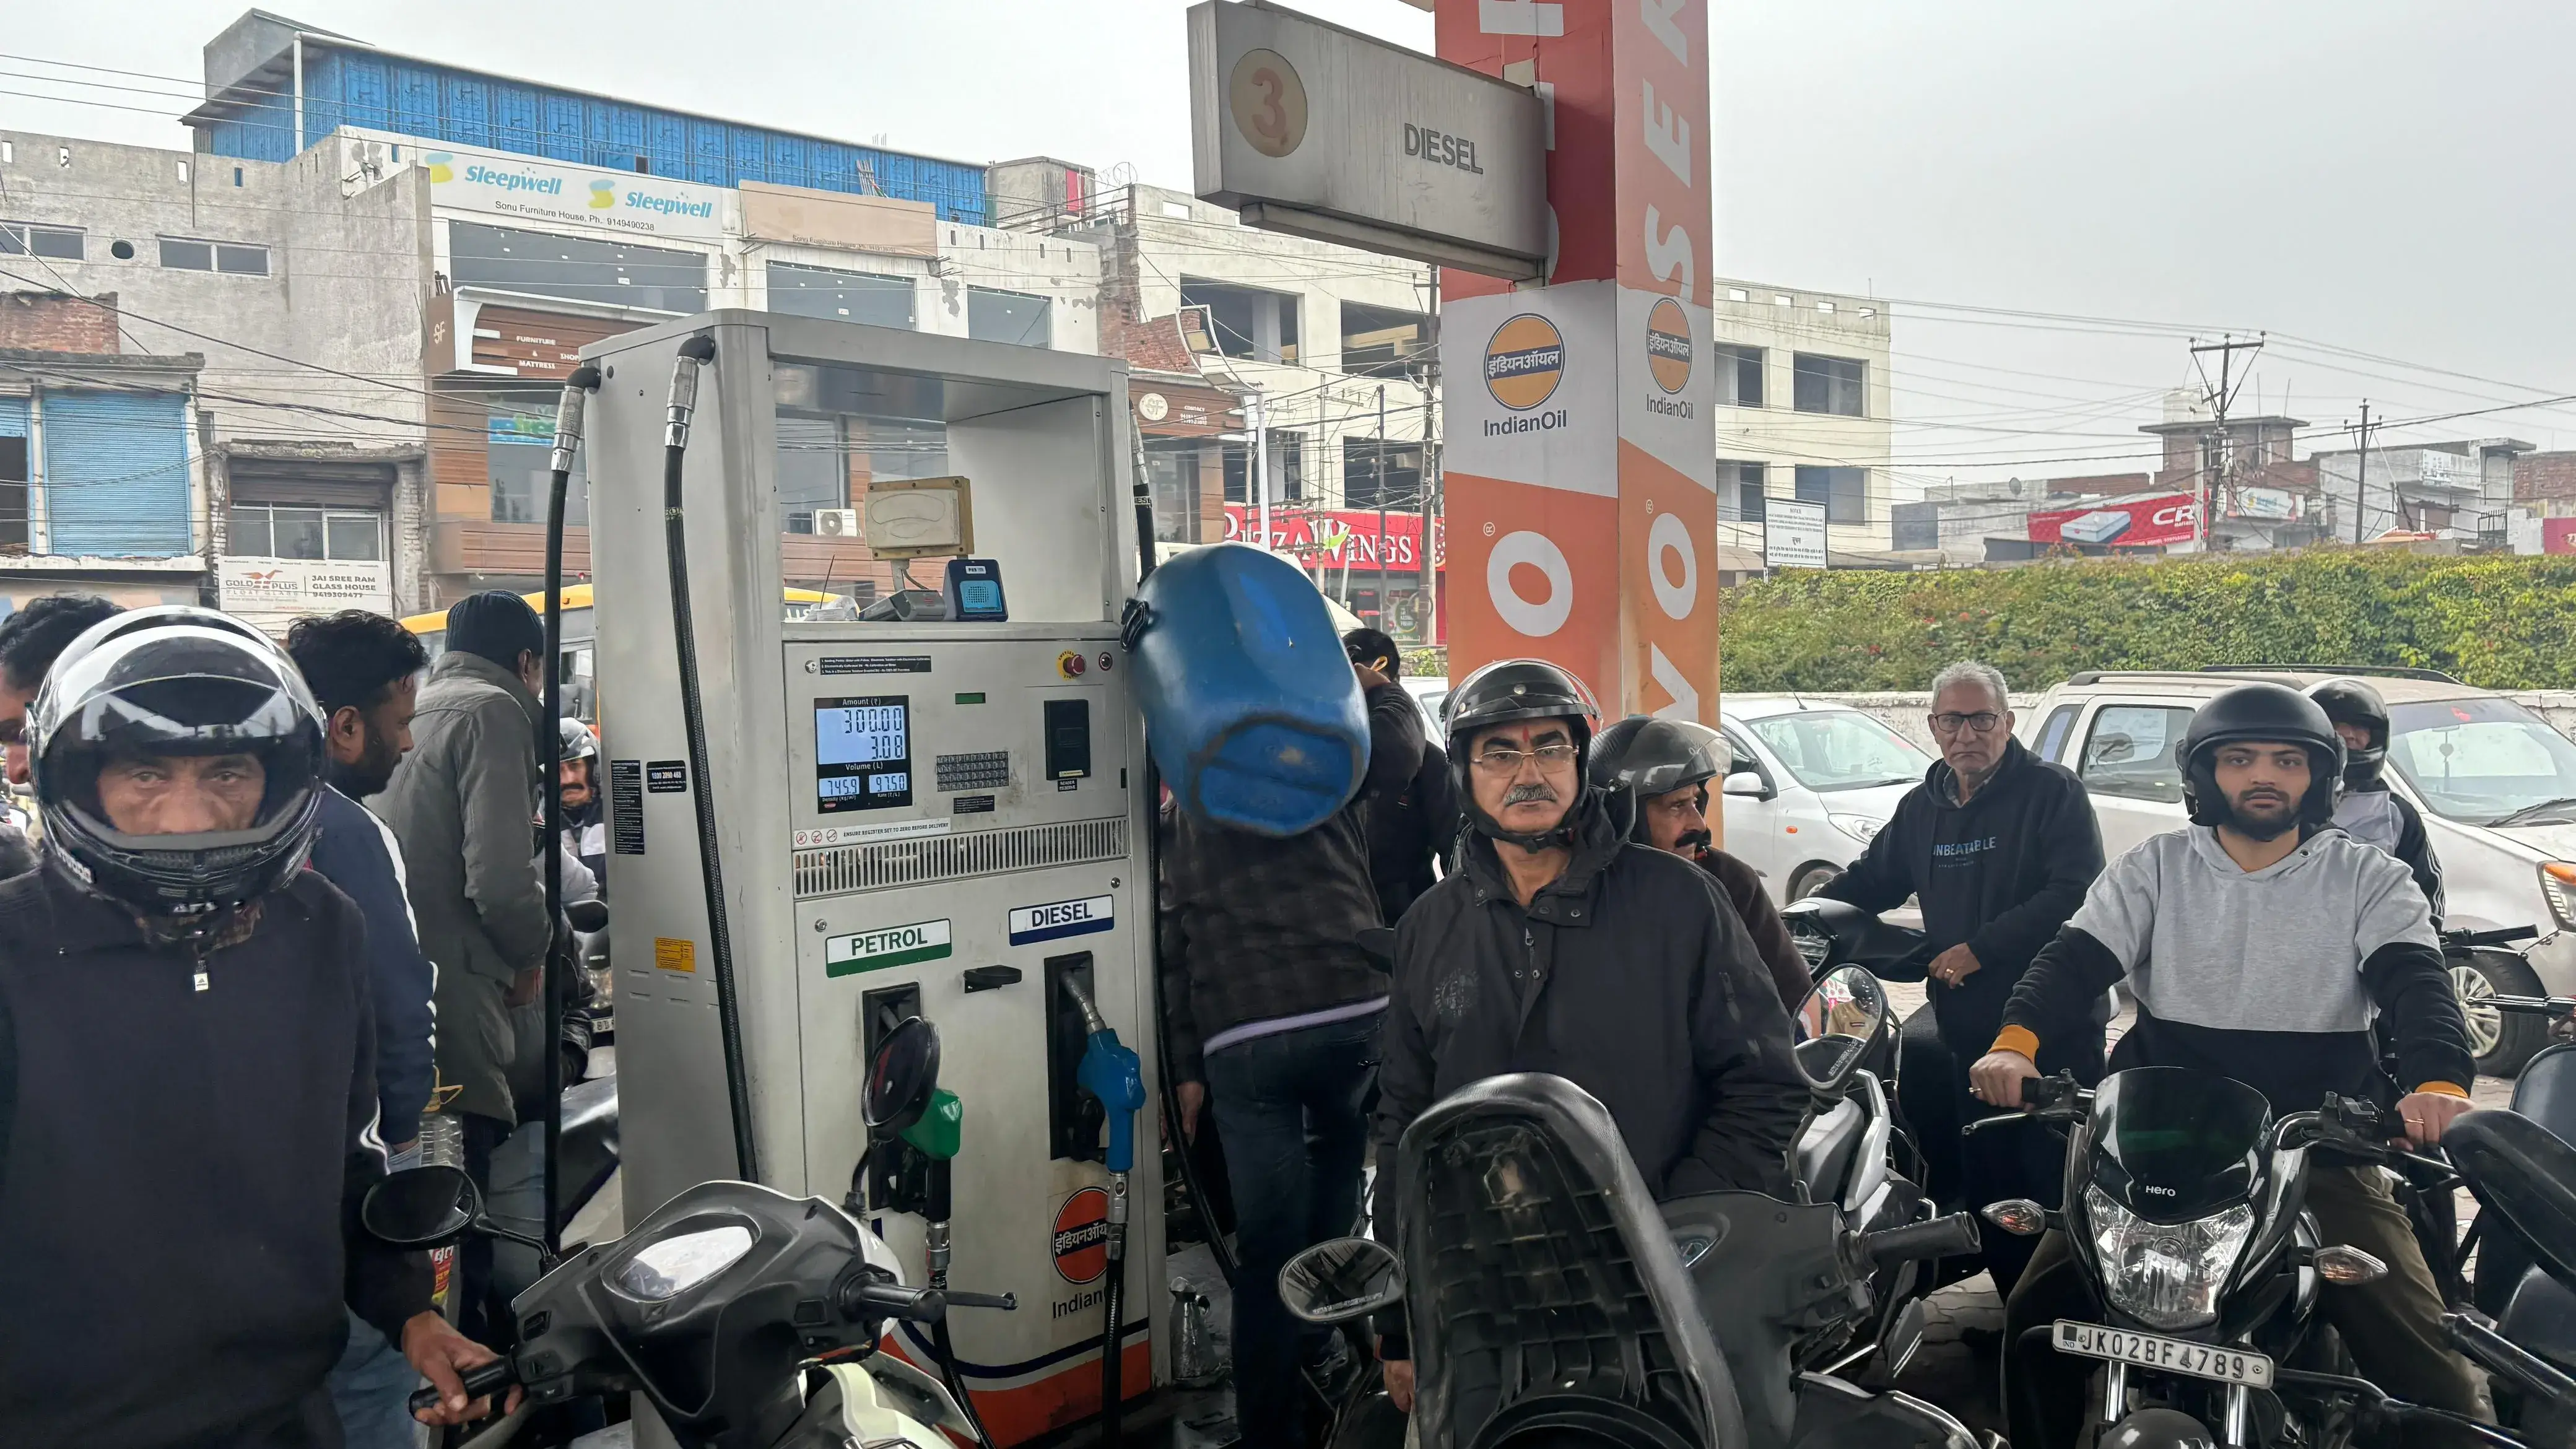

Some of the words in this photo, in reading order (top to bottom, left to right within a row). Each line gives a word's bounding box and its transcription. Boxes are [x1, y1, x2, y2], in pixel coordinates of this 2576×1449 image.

[1251, 67, 1289, 139] 3
[1404, 123, 1484, 175] DIESEL
[465, 165, 562, 195] Sleepwell
[495, 201, 517, 212] Sonu
[520, 204, 556, 217] Furniture
[589, 215, 603, 224] Ph.
[625, 191, 712, 219] Sleepwell
[516, 336, 556, 346] FURNITURE
[1649, 332, 1690, 357] इंडियनऑयल
[519, 360, 555, 369] MATTRESS
[1488, 350, 1560, 377] इंडियनऑयल
[1646, 394, 1694, 420] IndianOil
[1484, 410, 1567, 437] IndianOil
[272, 582, 298, 590] PLUS
[844, 708, 902, 734] 300.00
[871, 734, 903, 760] 3.08
[827, 778, 857, 796] 745.9
[876, 775, 905, 792] 97.50
[1031, 901, 1094, 928] DIESEL
[851, 927, 928, 957] PETROL
[2146, 1185, 2176, 1197] Hero
[1055, 1222, 1107, 1255] इंडियनऑय
[2082, 1328, 2245, 1380] JK02BF4789
